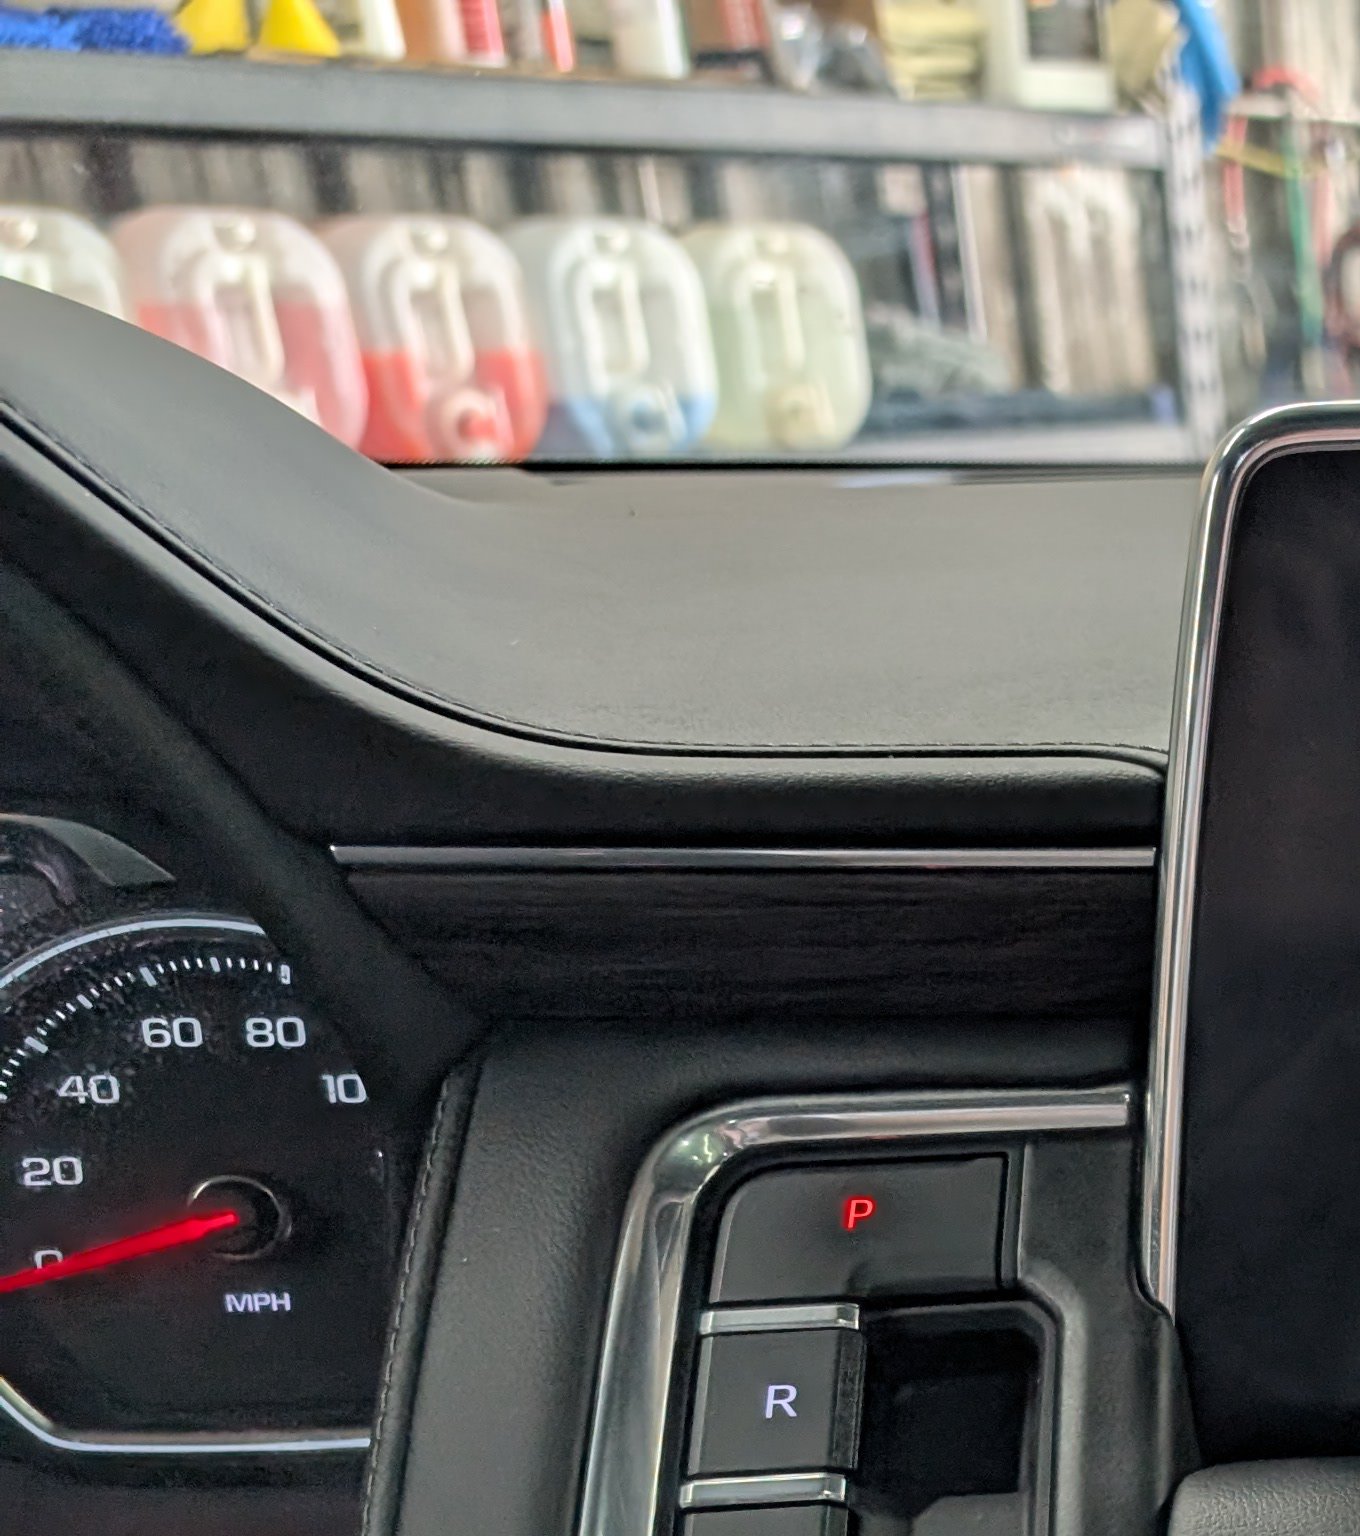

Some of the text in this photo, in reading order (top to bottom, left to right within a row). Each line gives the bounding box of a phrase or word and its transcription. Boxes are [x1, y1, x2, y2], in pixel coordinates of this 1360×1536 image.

[142, 1018, 202, 1047] 60
[246, 1017, 305, 1047] 80
[57, 1075, 119, 1103] 40
[22, 1157, 82, 1185] 20
[848, 1200, 873, 1228] P
[226, 1293, 290, 1312] MPH
[766, 1385, 796, 1418] R
